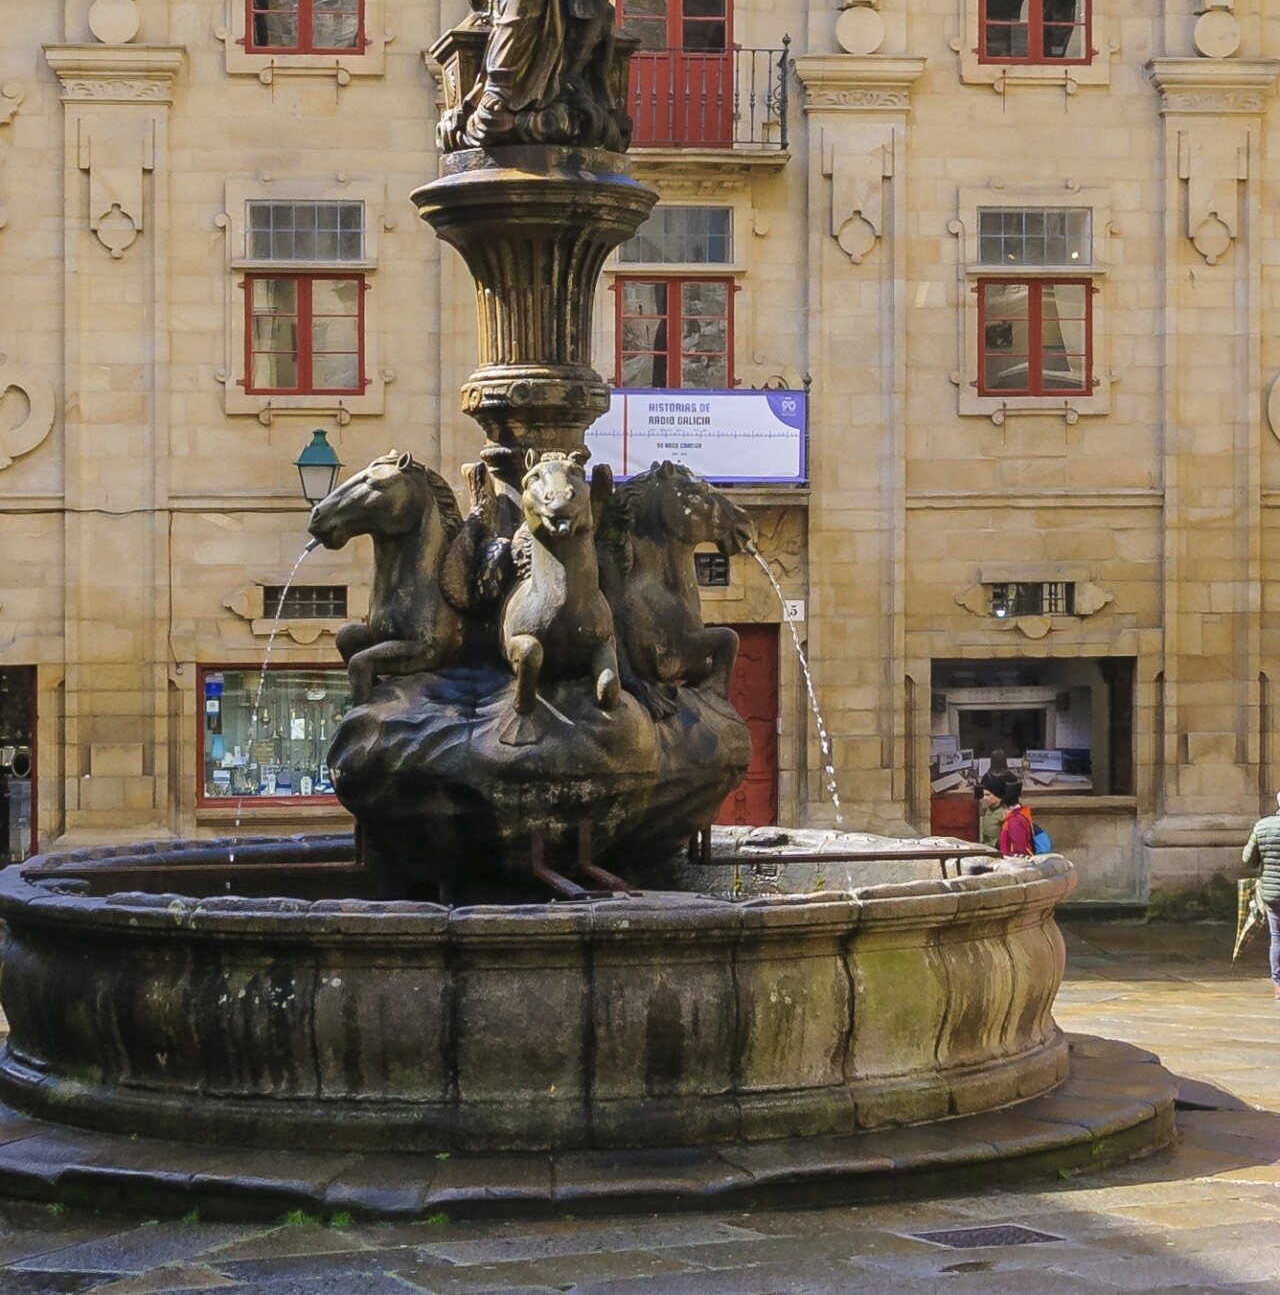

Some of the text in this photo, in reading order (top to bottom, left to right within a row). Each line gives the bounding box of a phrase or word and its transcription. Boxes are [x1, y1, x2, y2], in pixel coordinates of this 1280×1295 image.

[648, 403, 711, 413] HISTORIAS DE
[781, 400, 796, 411] 90
[648, 416, 711, 426] RADIO GALICIA
[789, 605, 798, 617] 5
